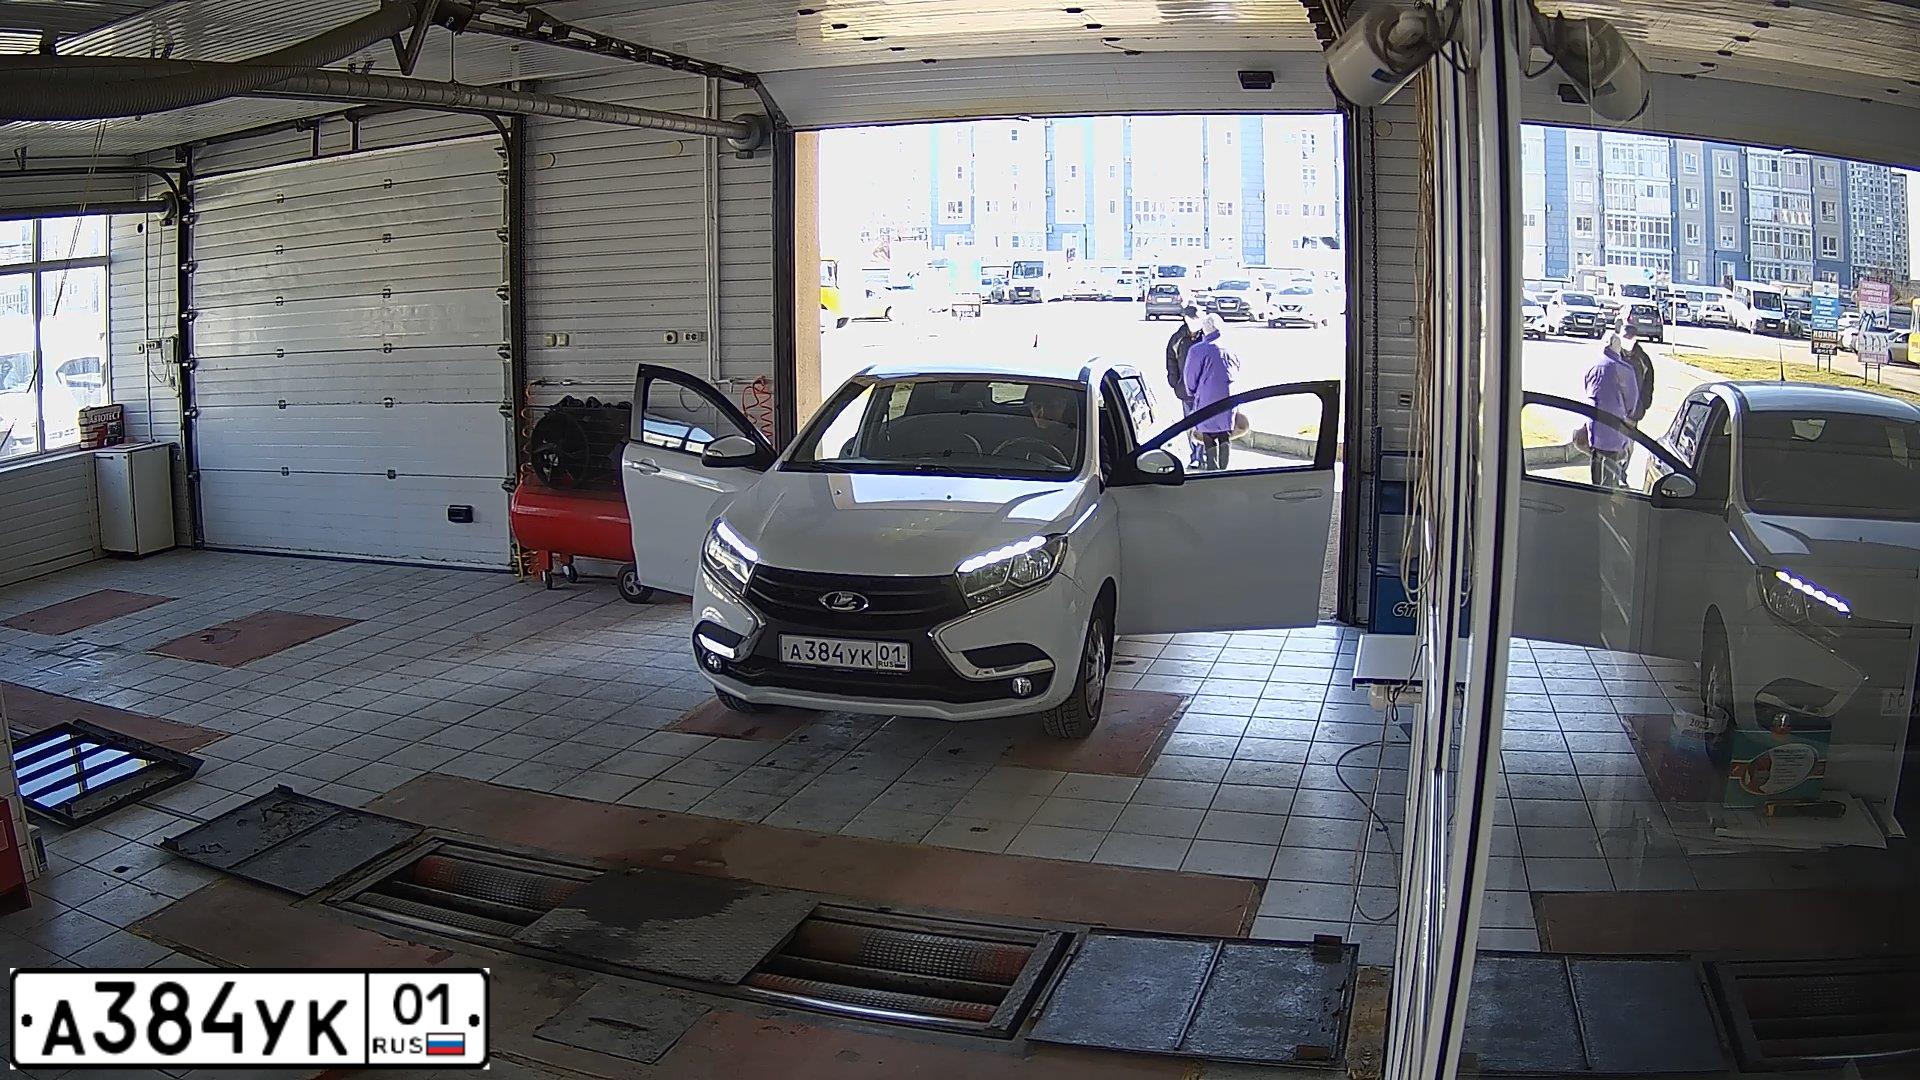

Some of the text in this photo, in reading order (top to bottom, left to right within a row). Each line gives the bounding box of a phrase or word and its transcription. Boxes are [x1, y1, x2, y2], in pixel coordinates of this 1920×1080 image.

[790, 640, 901, 666] А384УК 01
[878, 660, 894, 668] RUS
